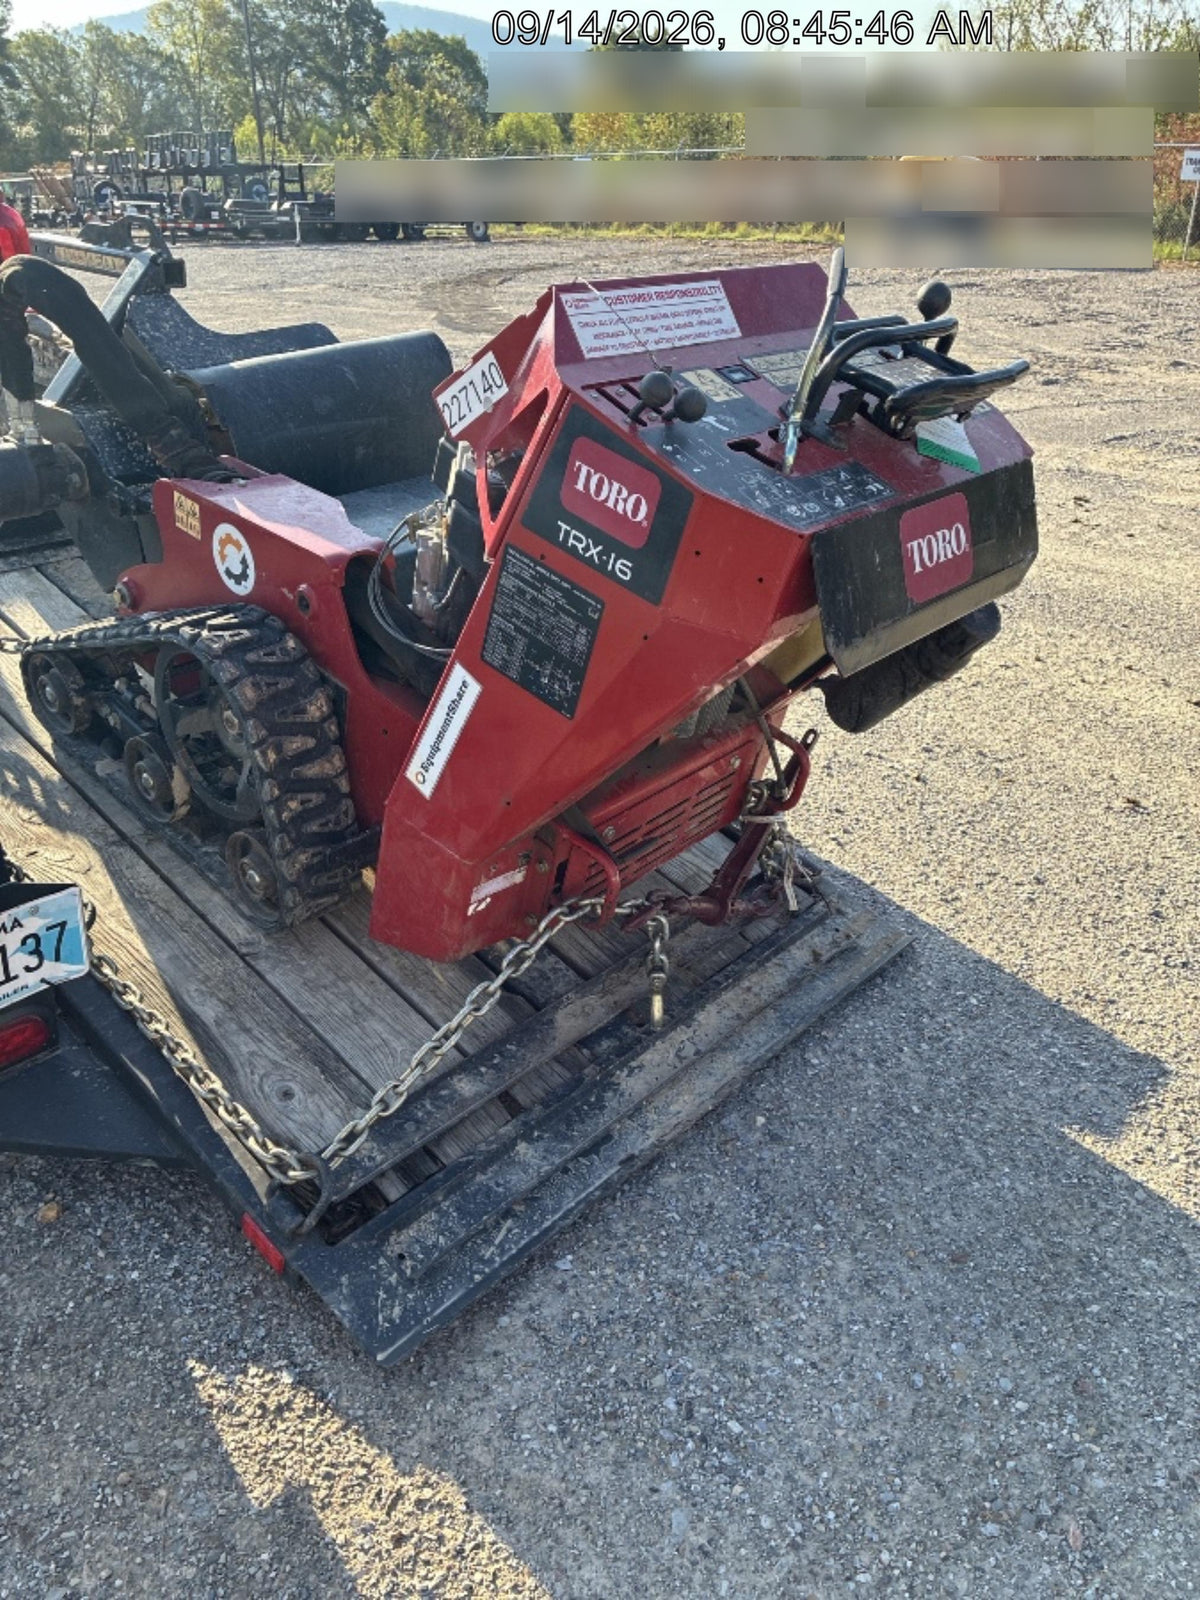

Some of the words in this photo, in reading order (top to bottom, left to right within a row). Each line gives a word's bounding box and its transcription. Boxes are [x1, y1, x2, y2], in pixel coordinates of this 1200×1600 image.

[604, 291, 654, 306] CUSTOMER
[655, 285, 723, 300] RESPONSIBILITY
[442, 361, 504, 429] 227140
[574, 460, 648, 522] TORO
[557, 520, 634, 581] TRX-16
[906, 522, 967, 575] TORO
[421, 679, 469, 773] EquipmentShare
[0, 920, 67, 987] 137
